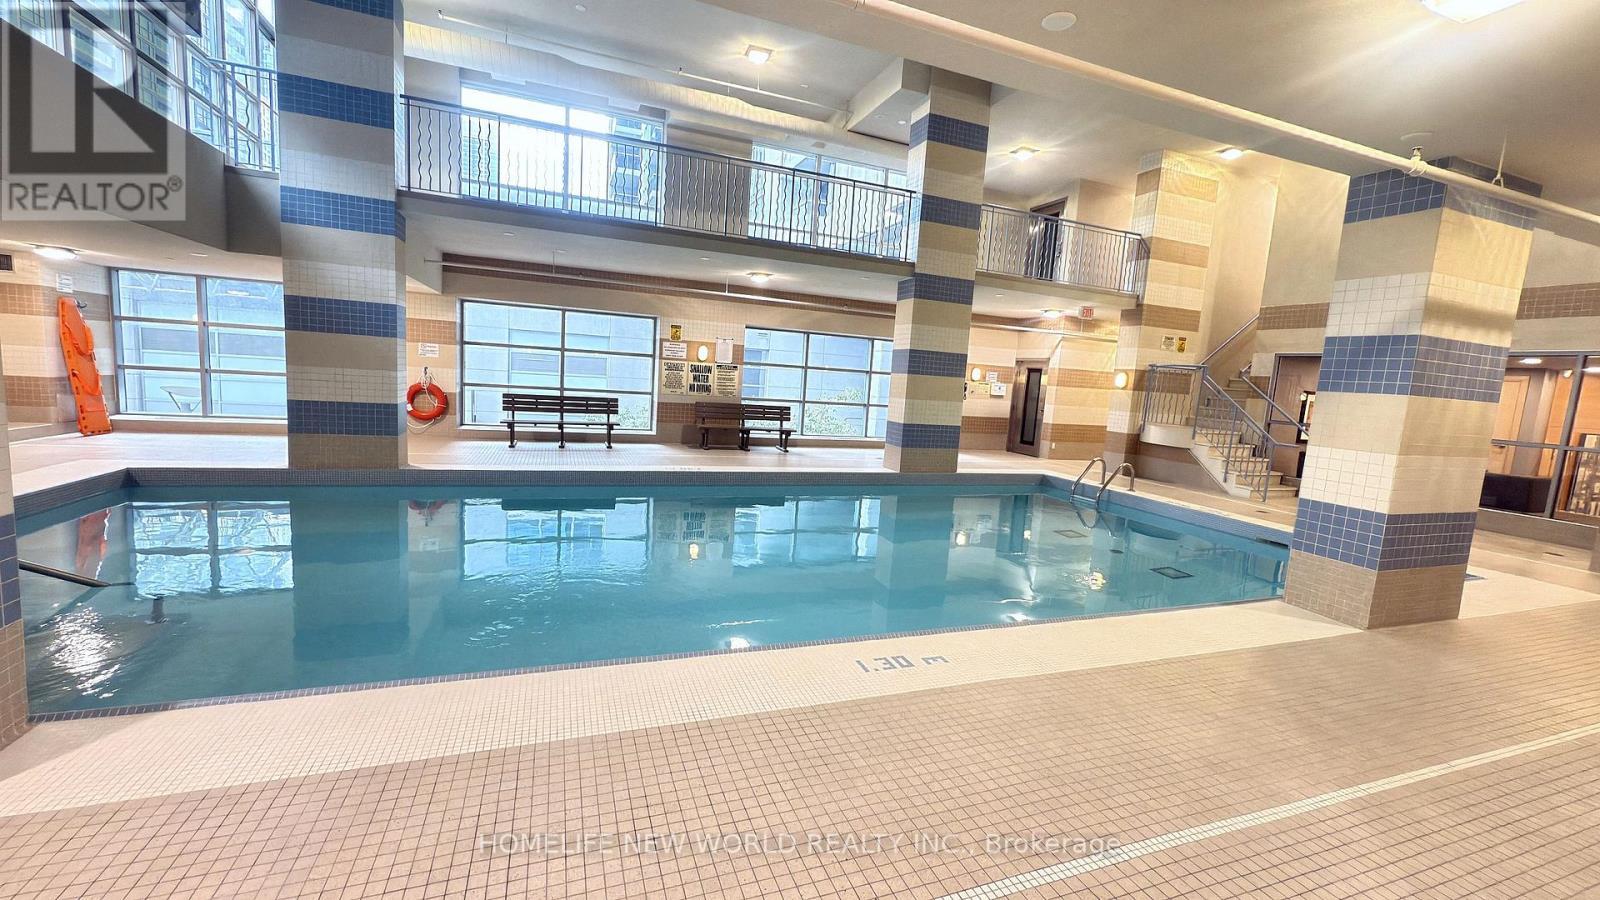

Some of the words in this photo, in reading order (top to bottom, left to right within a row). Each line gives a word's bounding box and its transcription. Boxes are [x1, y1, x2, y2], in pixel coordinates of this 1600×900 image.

[690, 364, 712, 374] SHALLOW
[693, 374, 709, 383] WATER
[689, 384, 695, 392] NO
[696, 384, 712, 393] DIVING
[855, 655, 915, 672] 1.30
